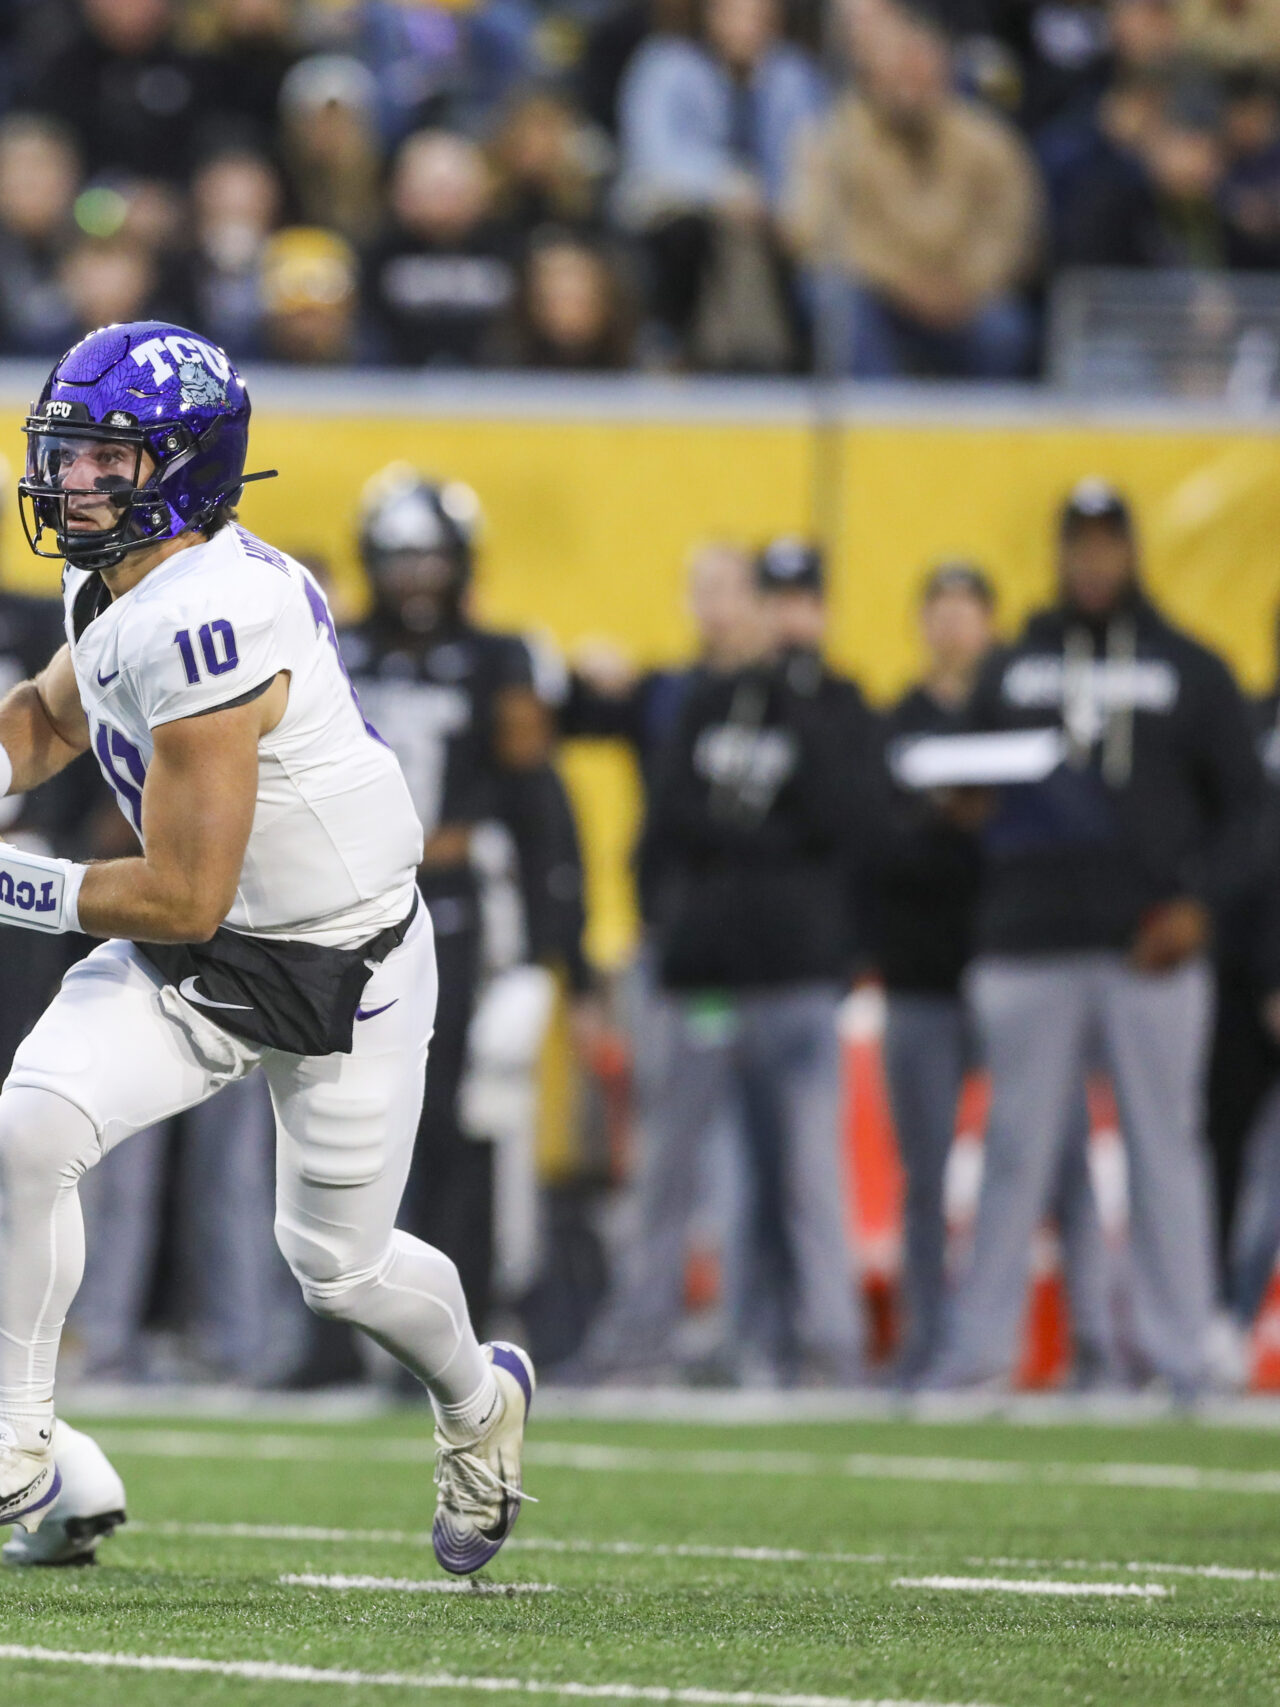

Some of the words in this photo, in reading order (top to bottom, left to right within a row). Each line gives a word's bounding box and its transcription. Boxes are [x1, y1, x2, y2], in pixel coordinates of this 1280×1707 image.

[130, 336, 231, 387] TCU
[46, 401, 72, 418] TCU
[171, 617, 240, 687] 10
